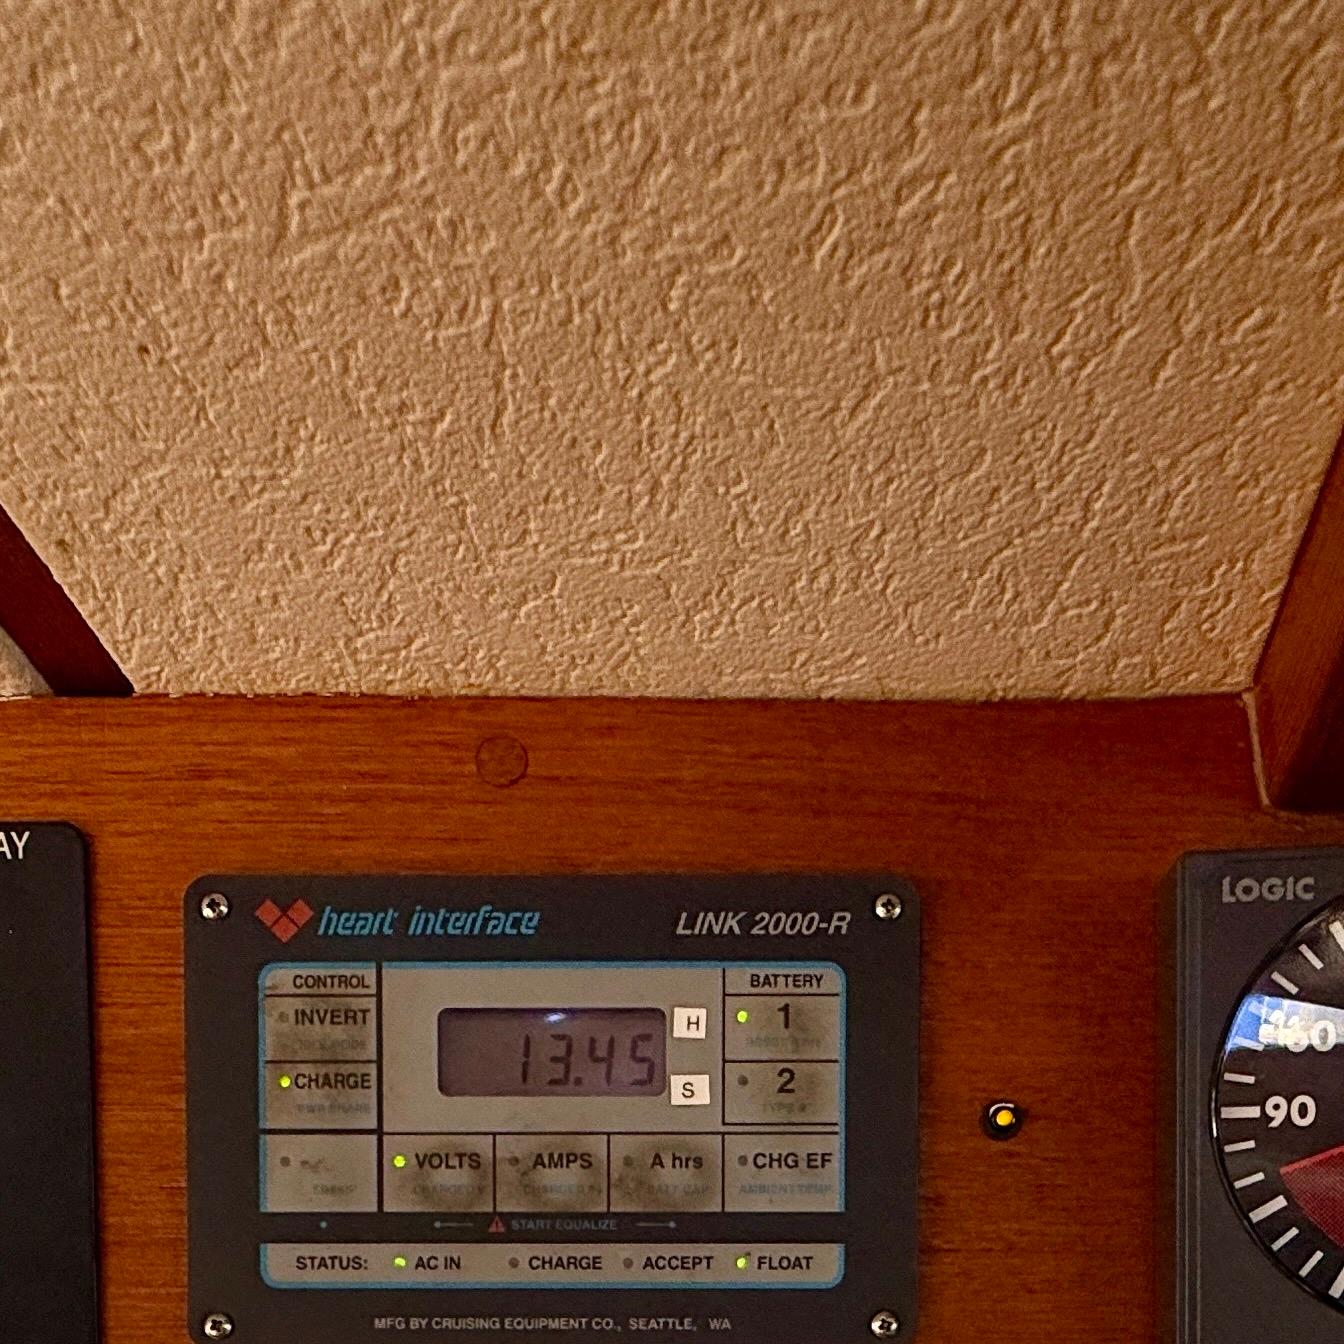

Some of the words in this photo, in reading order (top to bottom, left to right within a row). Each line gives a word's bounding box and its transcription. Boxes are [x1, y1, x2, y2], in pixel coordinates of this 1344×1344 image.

[1221, 876, 1315, 902] LOGIC
[317, 904, 399, 936] heart
[407, 904, 541, 936] interface
[675, 911, 748, 935] LINK
[750, 911, 852, 935] 2000-R
[292, 974, 370, 989] CONTROL
[750, 974, 824, 989] BATTERY
[294, 1008, 371, 1026] INVERT
[686, 1015, 700, 1031] H
[777, 1003, 791, 1029] 1
[521, 1033, 655, 1086] 13.45
[294, 1072, 372, 1090] CHARGE
[776, 1068, 796, 1094] 2
[681, 1081, 695, 1099] S
[1265, 1095, 1316, 1128] 90
[414, 1152, 481, 1169] VOLTS
[533, 1152, 593, 1169] AMPS
[650, 1153, 665, 1169] A
[671, 1153, 704, 1169] hrs
[752, 1152, 799, 1169] CHG
[807, 1152, 833, 1168] EF
[511, 1219, 551, 1230] START
[556, 1218, 617, 1230] EQUALIZE
[296, 1256, 368, 1271] STATUS:
[415, 1256, 439, 1270] AC
[444, 1256, 461, 1270] IN
[528, 1256, 603, 1270] CHARGE
[643, 1256, 714, 1270] ACCEPT
[757, 1256, 813, 1270] FLOAT
[374, 1318, 406, 1330] MFG
[410, 1318, 429, 1330] BY
[432, 1318, 501, 1330] CRUISING
[504, 1318, 588, 1330] EQUIPMENT
[591, 1318, 622, 1332] CO.,
[629, 1318, 697, 1331] SEATTLE,
[709, 1318, 732, 1330] WA
